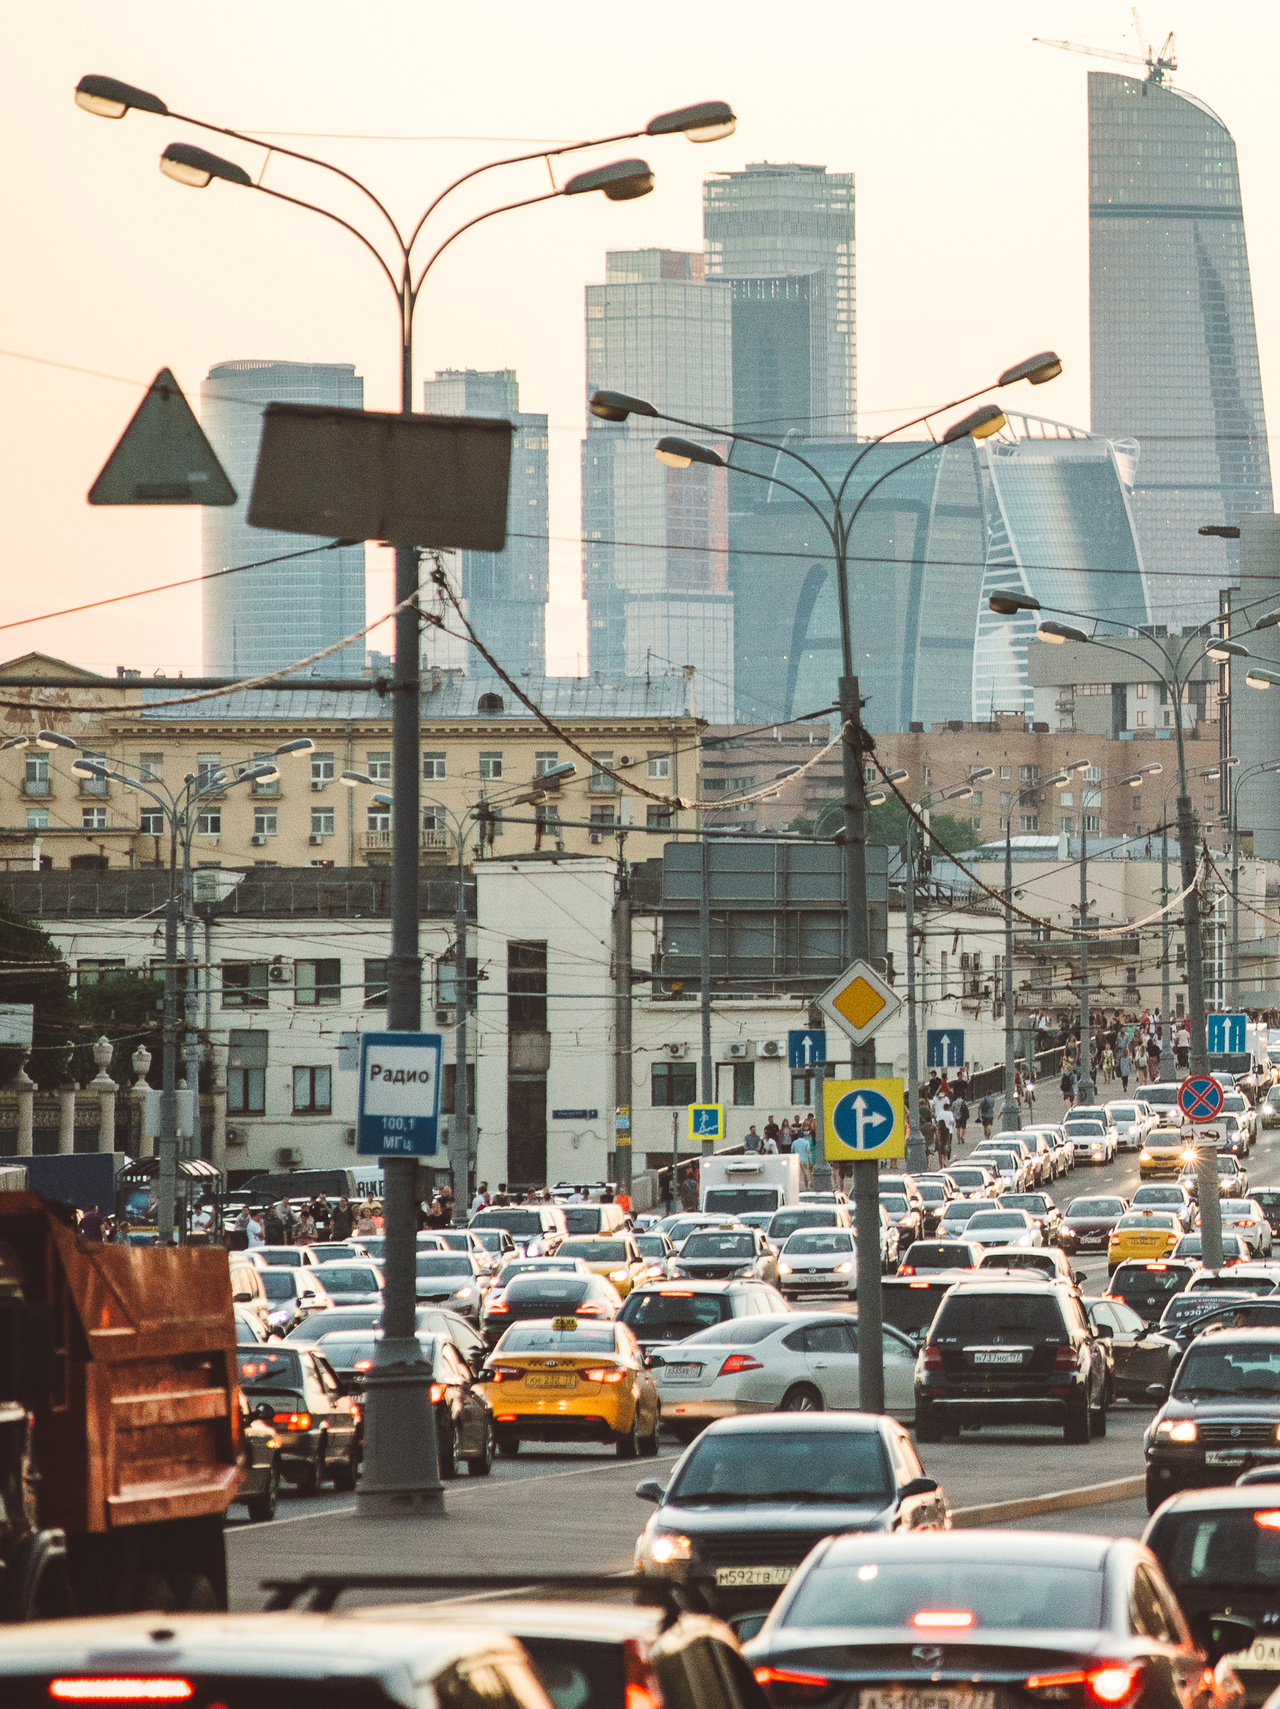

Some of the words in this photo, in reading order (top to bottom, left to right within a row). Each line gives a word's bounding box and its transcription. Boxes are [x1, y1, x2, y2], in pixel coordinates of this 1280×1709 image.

[370, 1064, 429, 1084] Радио
[382, 1118, 414, 1131] 100,1
[383, 1136, 411, 1151] МГц
[719, 1571, 771, 1584] М592ТВ
